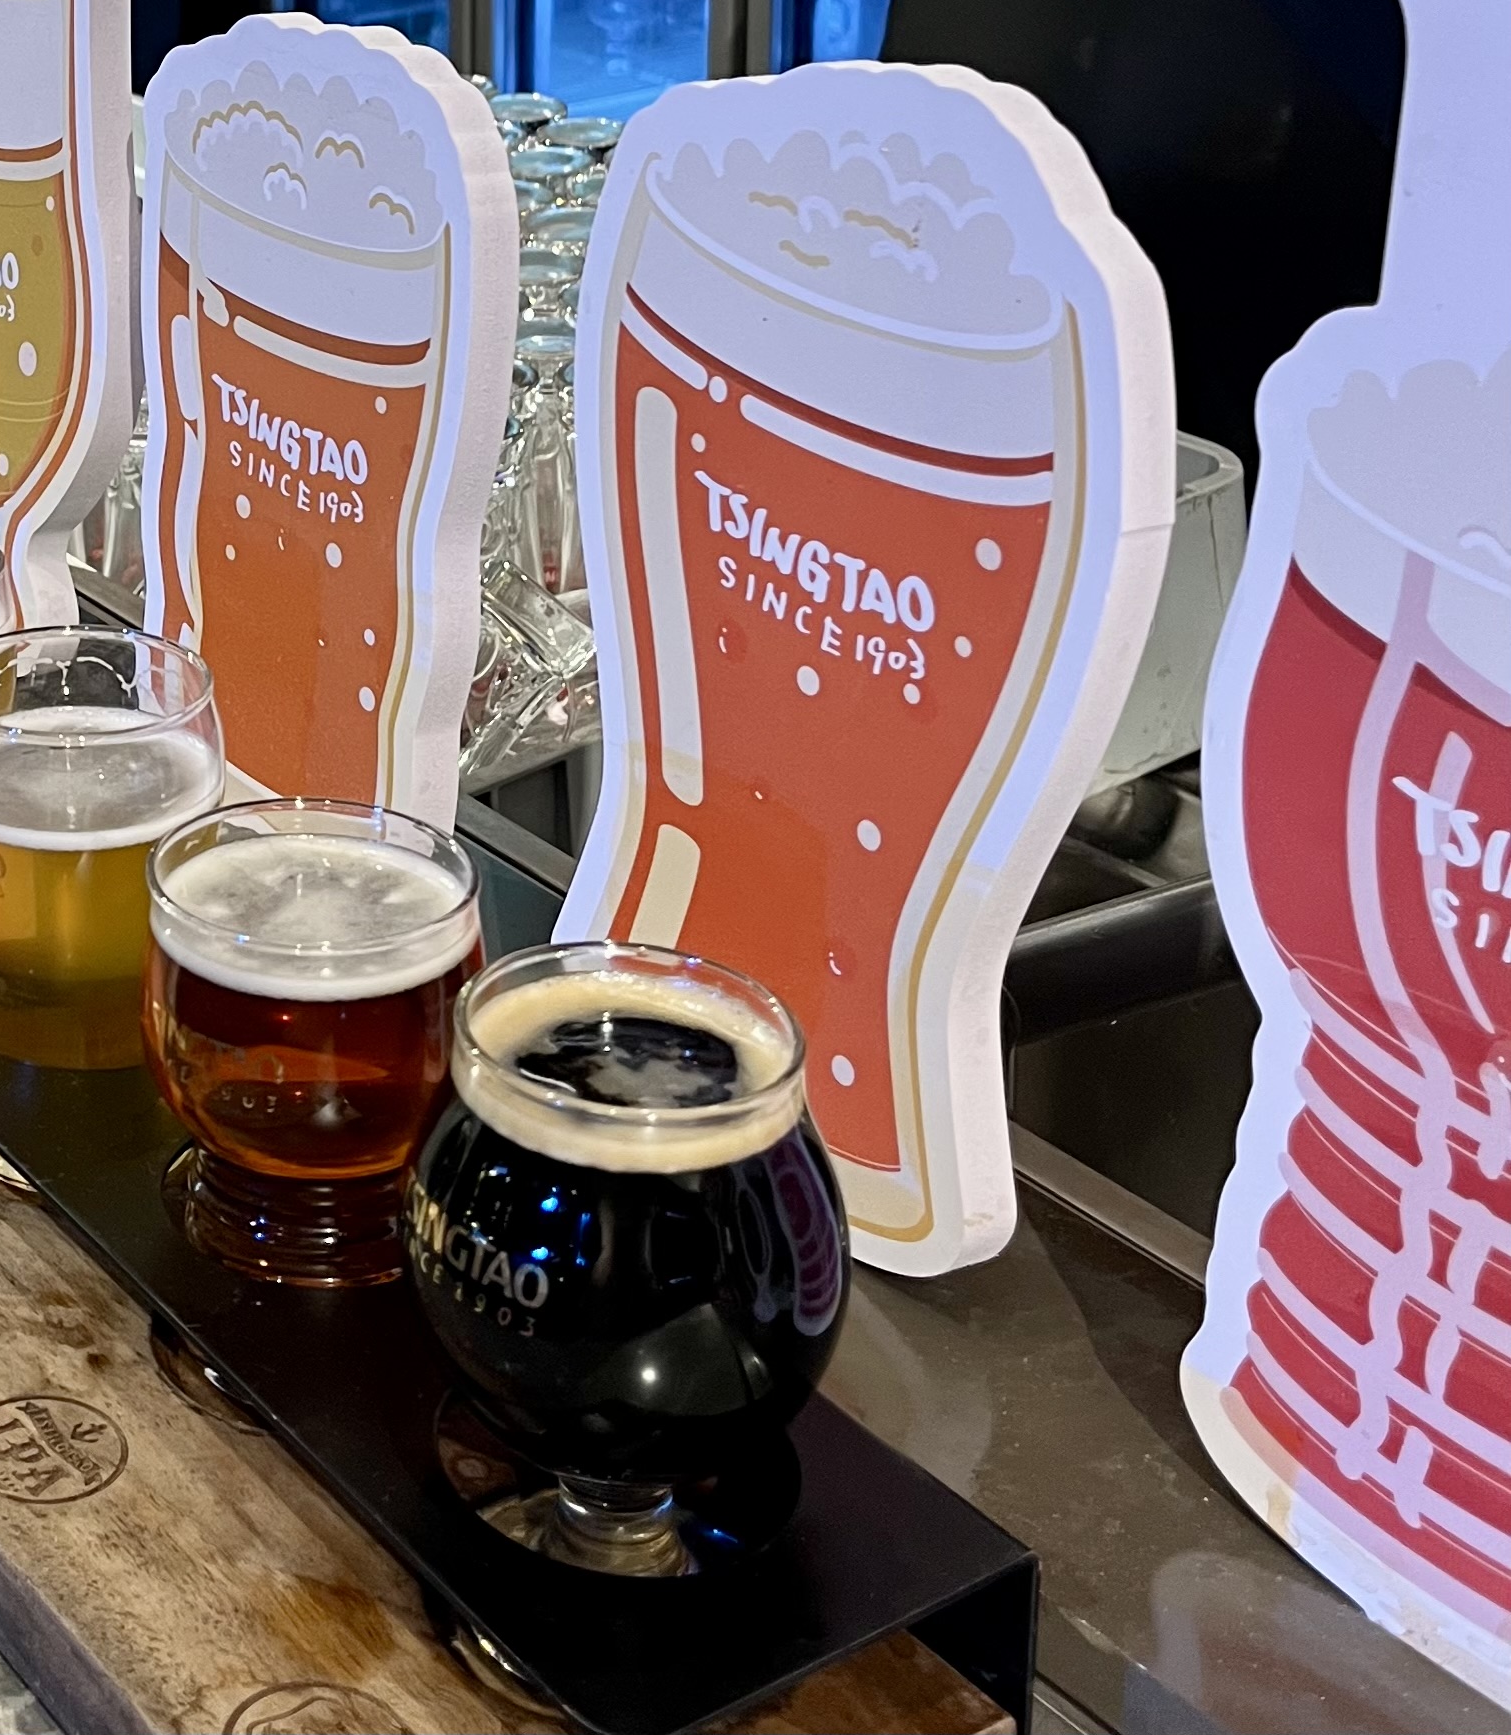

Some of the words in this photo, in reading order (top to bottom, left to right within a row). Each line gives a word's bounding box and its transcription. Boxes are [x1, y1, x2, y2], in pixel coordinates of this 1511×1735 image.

[211, 373, 369, 485] TSINGTAO
[229, 440, 311, 512] SINCE
[319, 490, 364, 524] 1903
[694, 470, 935, 633] TSINGTAO
[718, 556, 843, 657] SINCE
[854, 634, 925, 680] 1903
